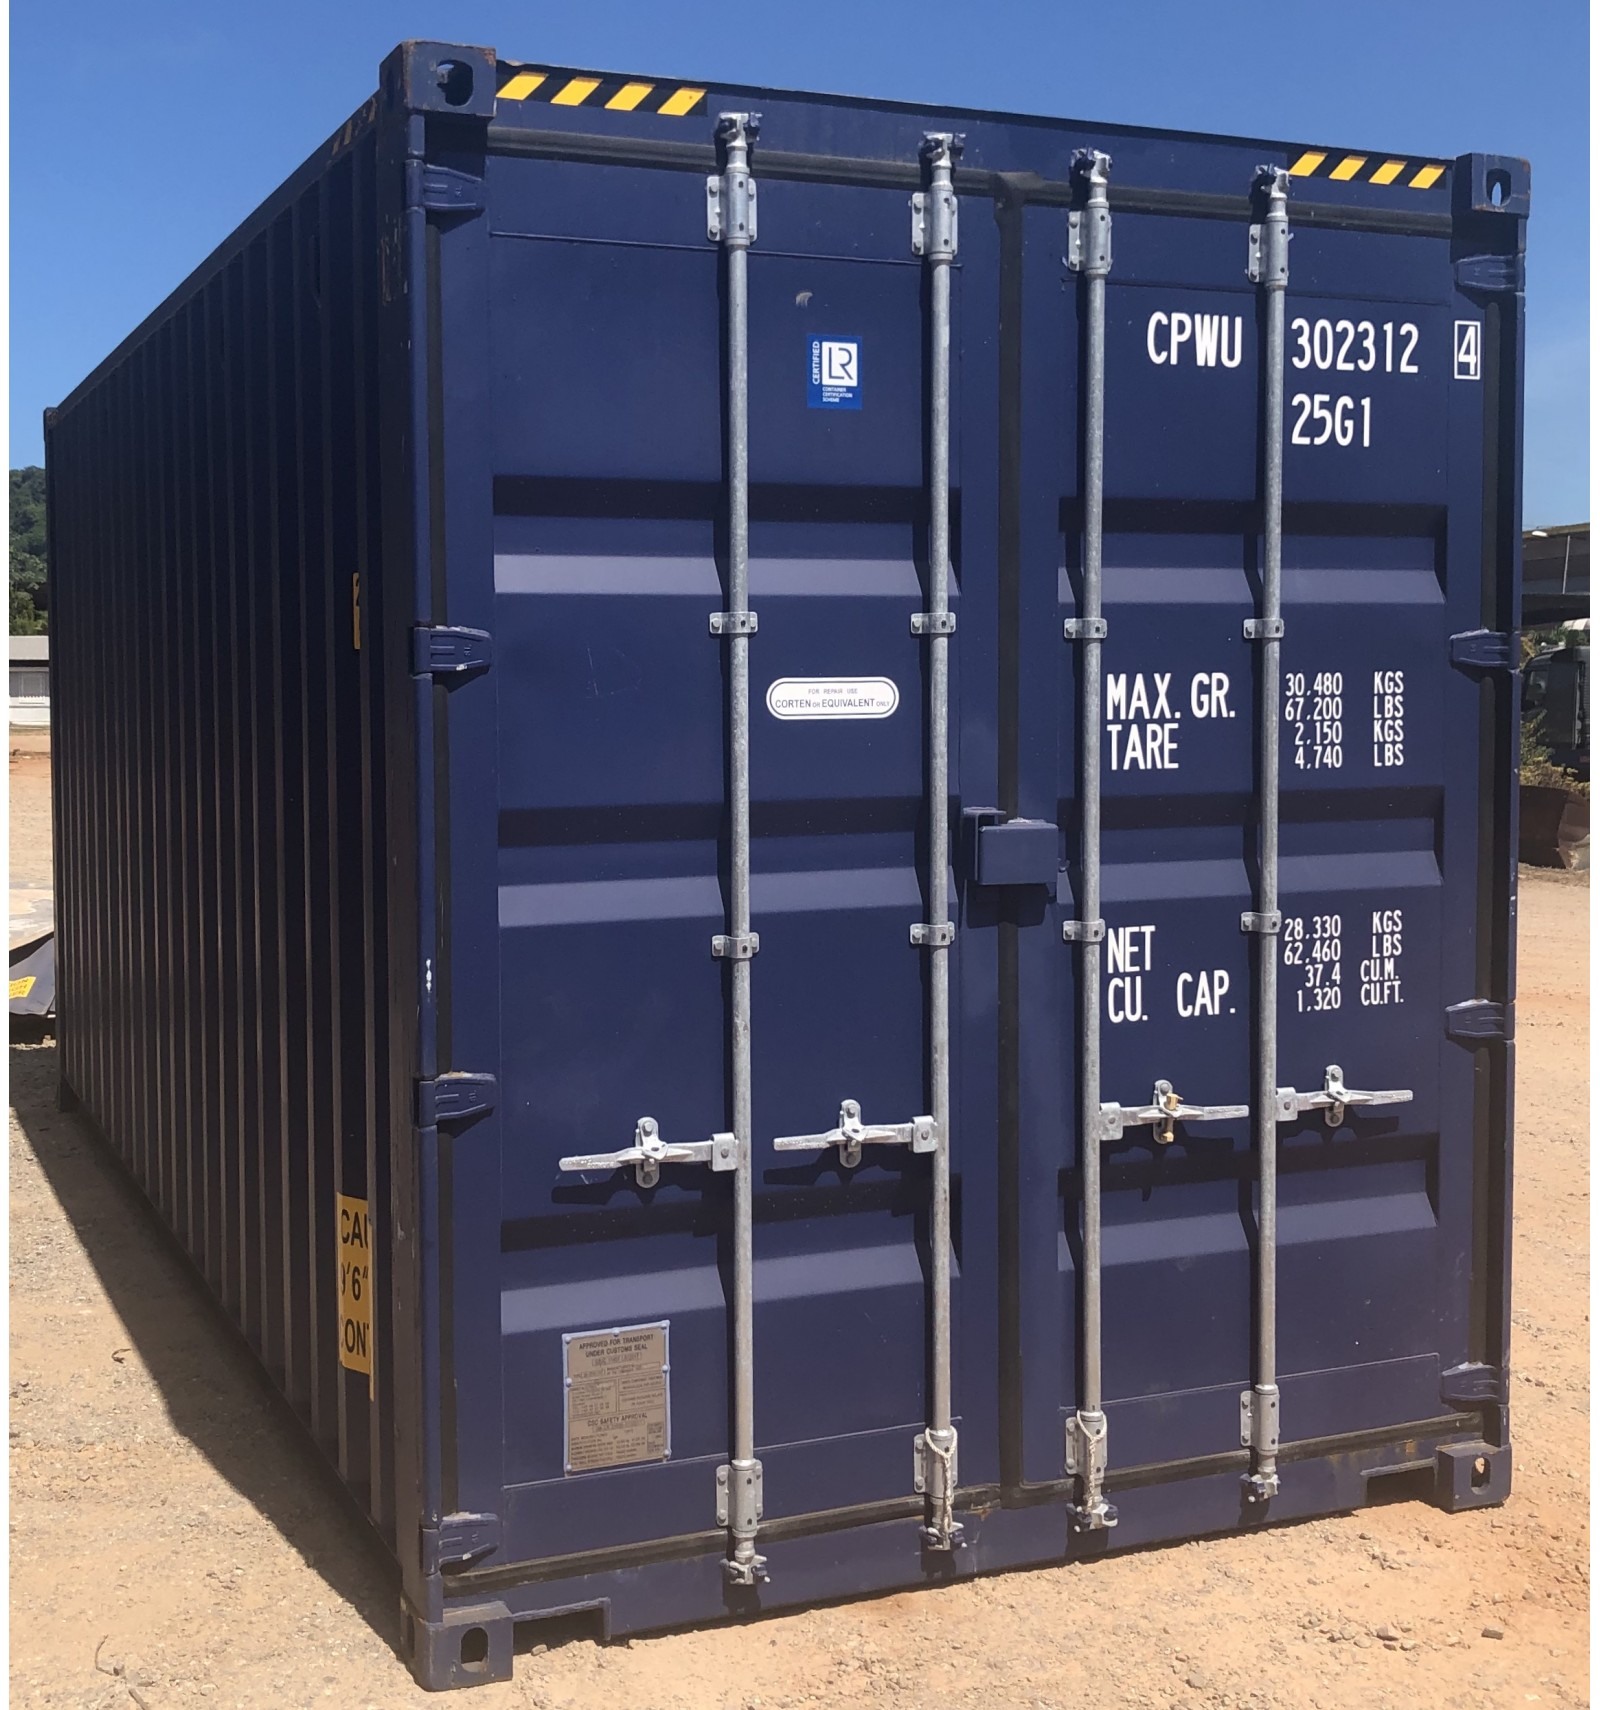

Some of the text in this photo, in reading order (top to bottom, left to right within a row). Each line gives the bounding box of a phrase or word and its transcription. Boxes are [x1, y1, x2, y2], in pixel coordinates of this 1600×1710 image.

[1147, 311, 1476, 375] CPWU 302312 4
[812, 341, 820, 385] CERTIFIED
[1291, 393, 1371, 447] 25G1
[1374, 671, 1404, 694] KGS
[775, 699, 811, 708] CORTEN
[821, 698, 875, 708] EQUIVALENT
[1107, 672, 1236, 720] MAX. GR.
[1374, 695, 1404, 718] LBS
[1373, 719, 1404, 743] KGS
[1106, 722, 1179, 770] TARE
[1374, 743, 1404, 767] LBS
[1372, 910, 1403, 934] KGS
[1107, 925, 1155, 974] NET
[1372, 933, 1402, 958] LBS
[1305, 962, 1341, 987] 37.4
[1107, 969, 1236, 1023] CU. CAP.
[579, 1334, 654, 1350] APPROVED FOR TRANSPORT
[585, 1350, 604, 1358] UNDER
[606, 1345, 632, 1354] CUSTOMS
[600, 1416, 619, 1425] SAFETY
[621, 1412, 648, 1421] APPROVAL
